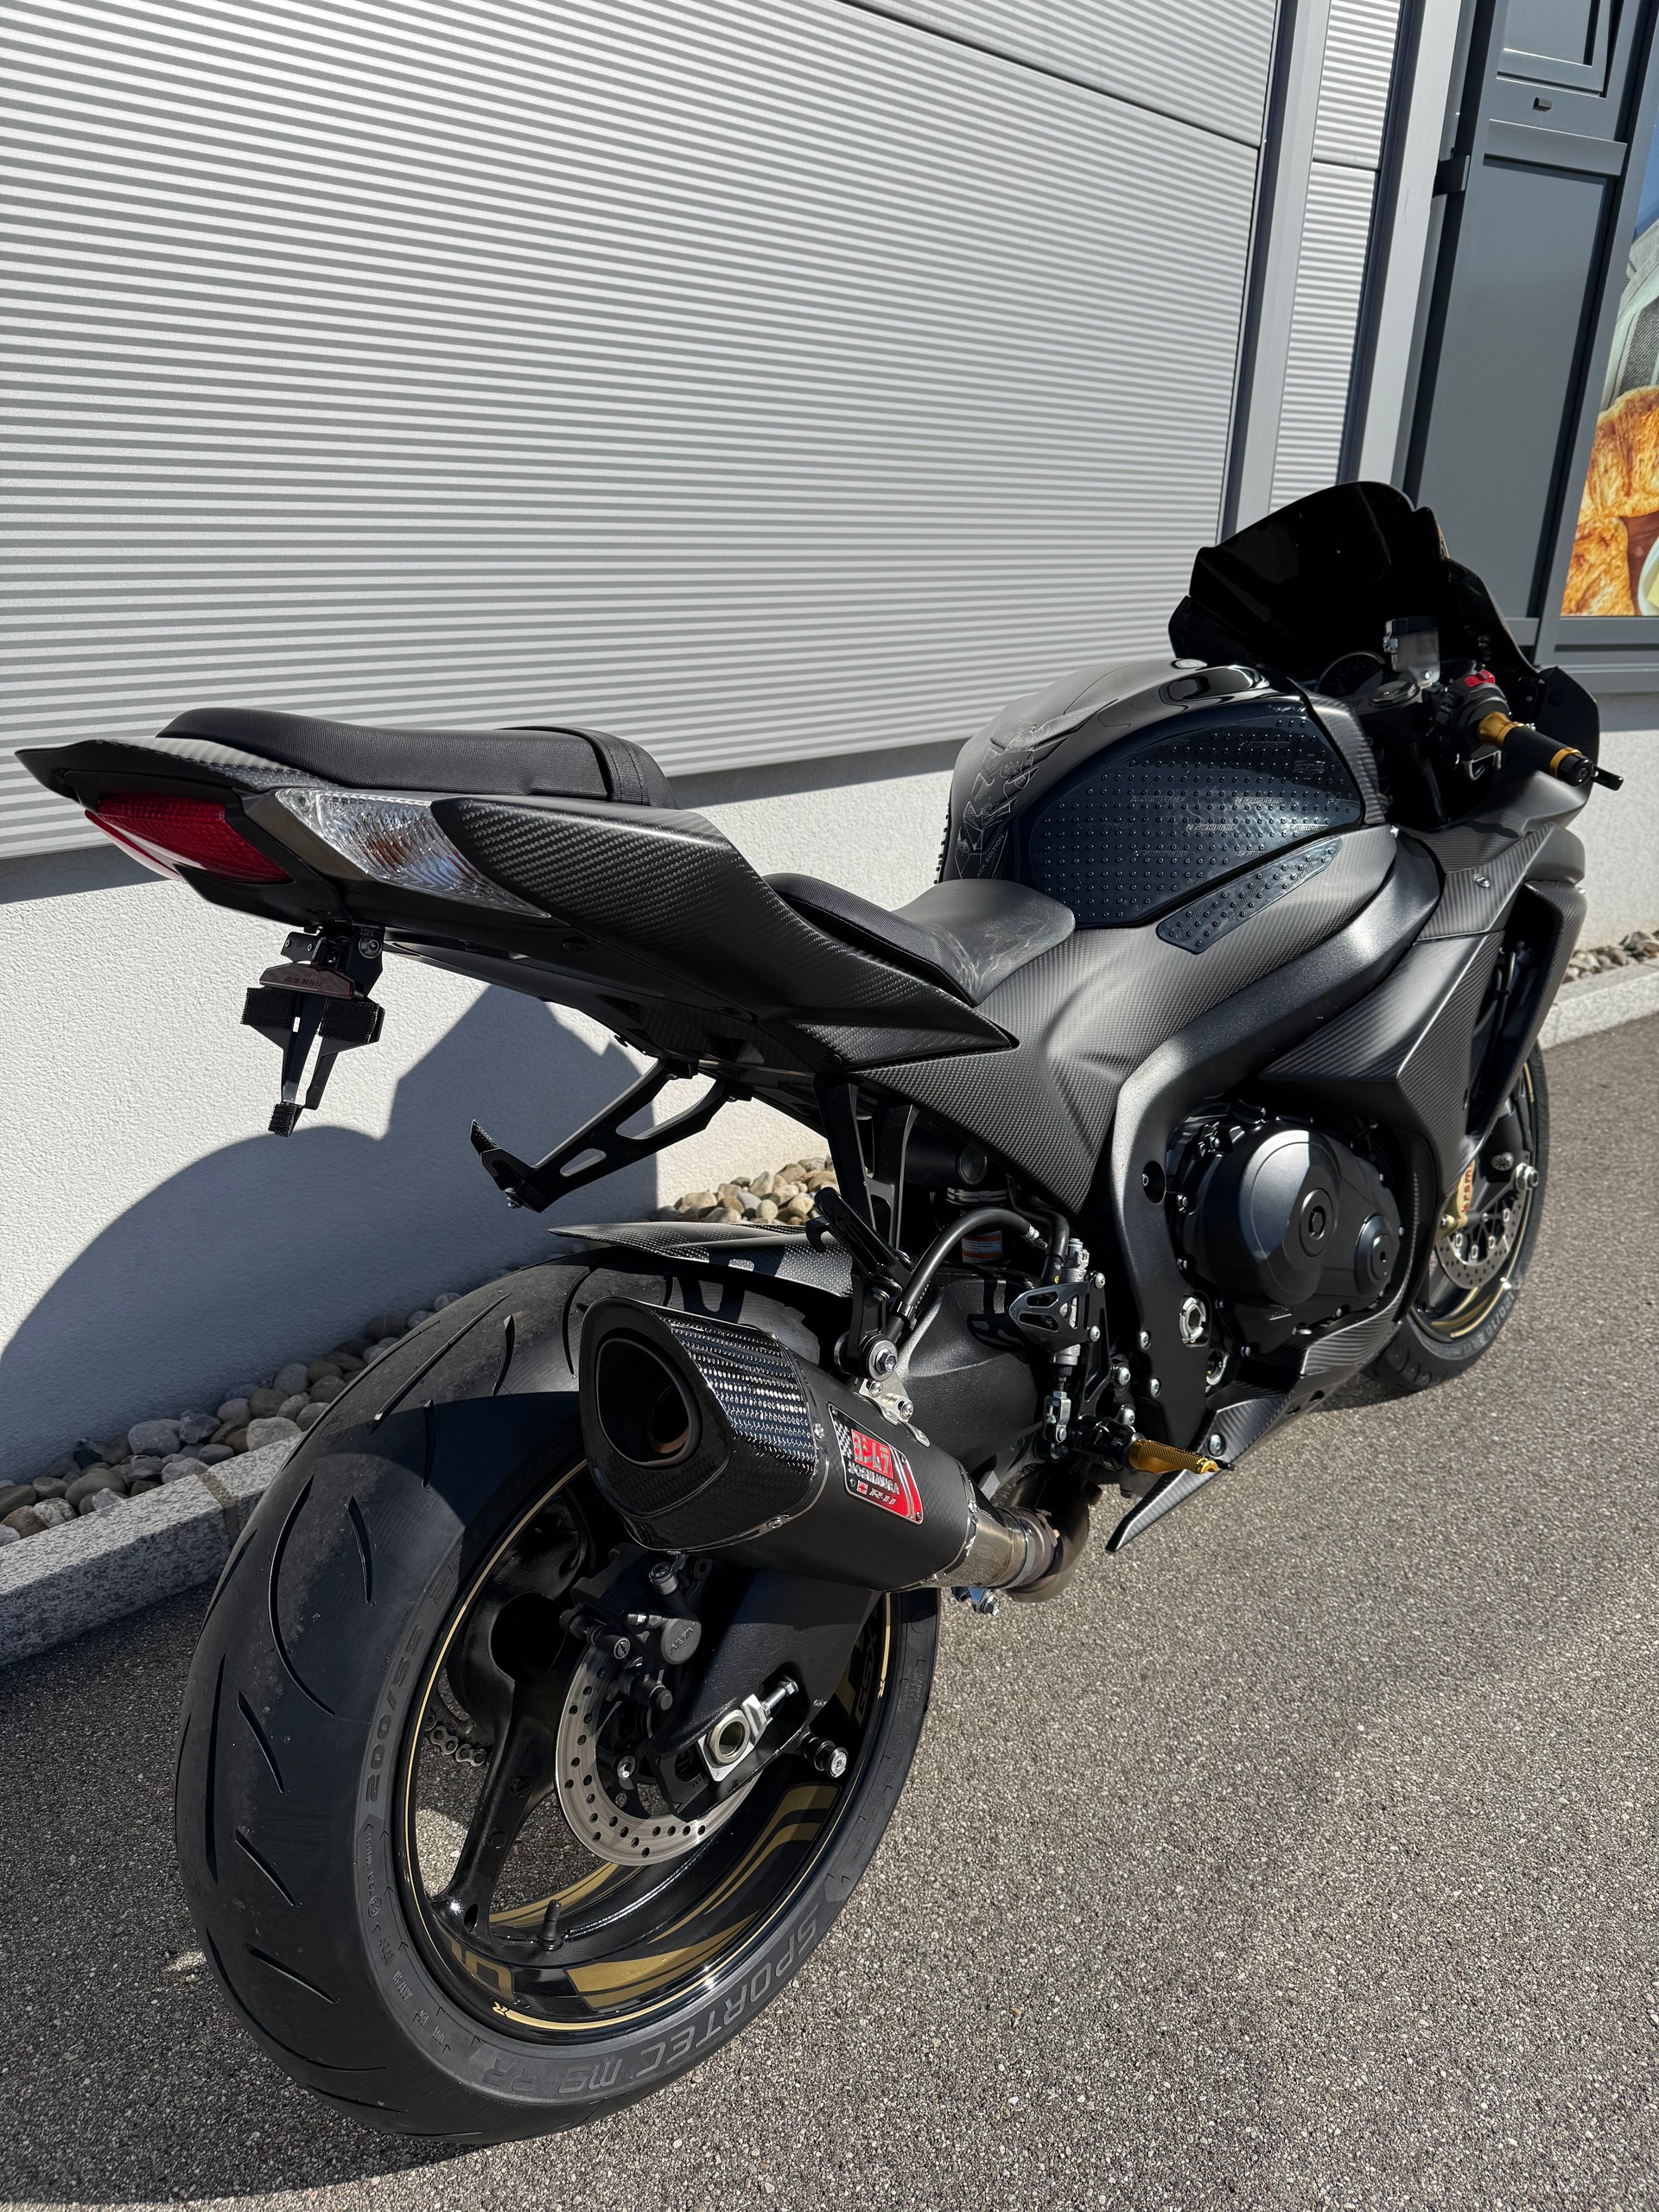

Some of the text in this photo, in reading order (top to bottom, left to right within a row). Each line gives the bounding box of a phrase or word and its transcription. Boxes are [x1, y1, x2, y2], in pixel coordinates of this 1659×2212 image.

[976, 834, 1005, 878] ACK EDITION
[848, 1460, 900, 1496] YOSHIMURA
[365, 1623, 424, 1803] 200/55
[636, 1903, 819, 2079] SPORTEC
